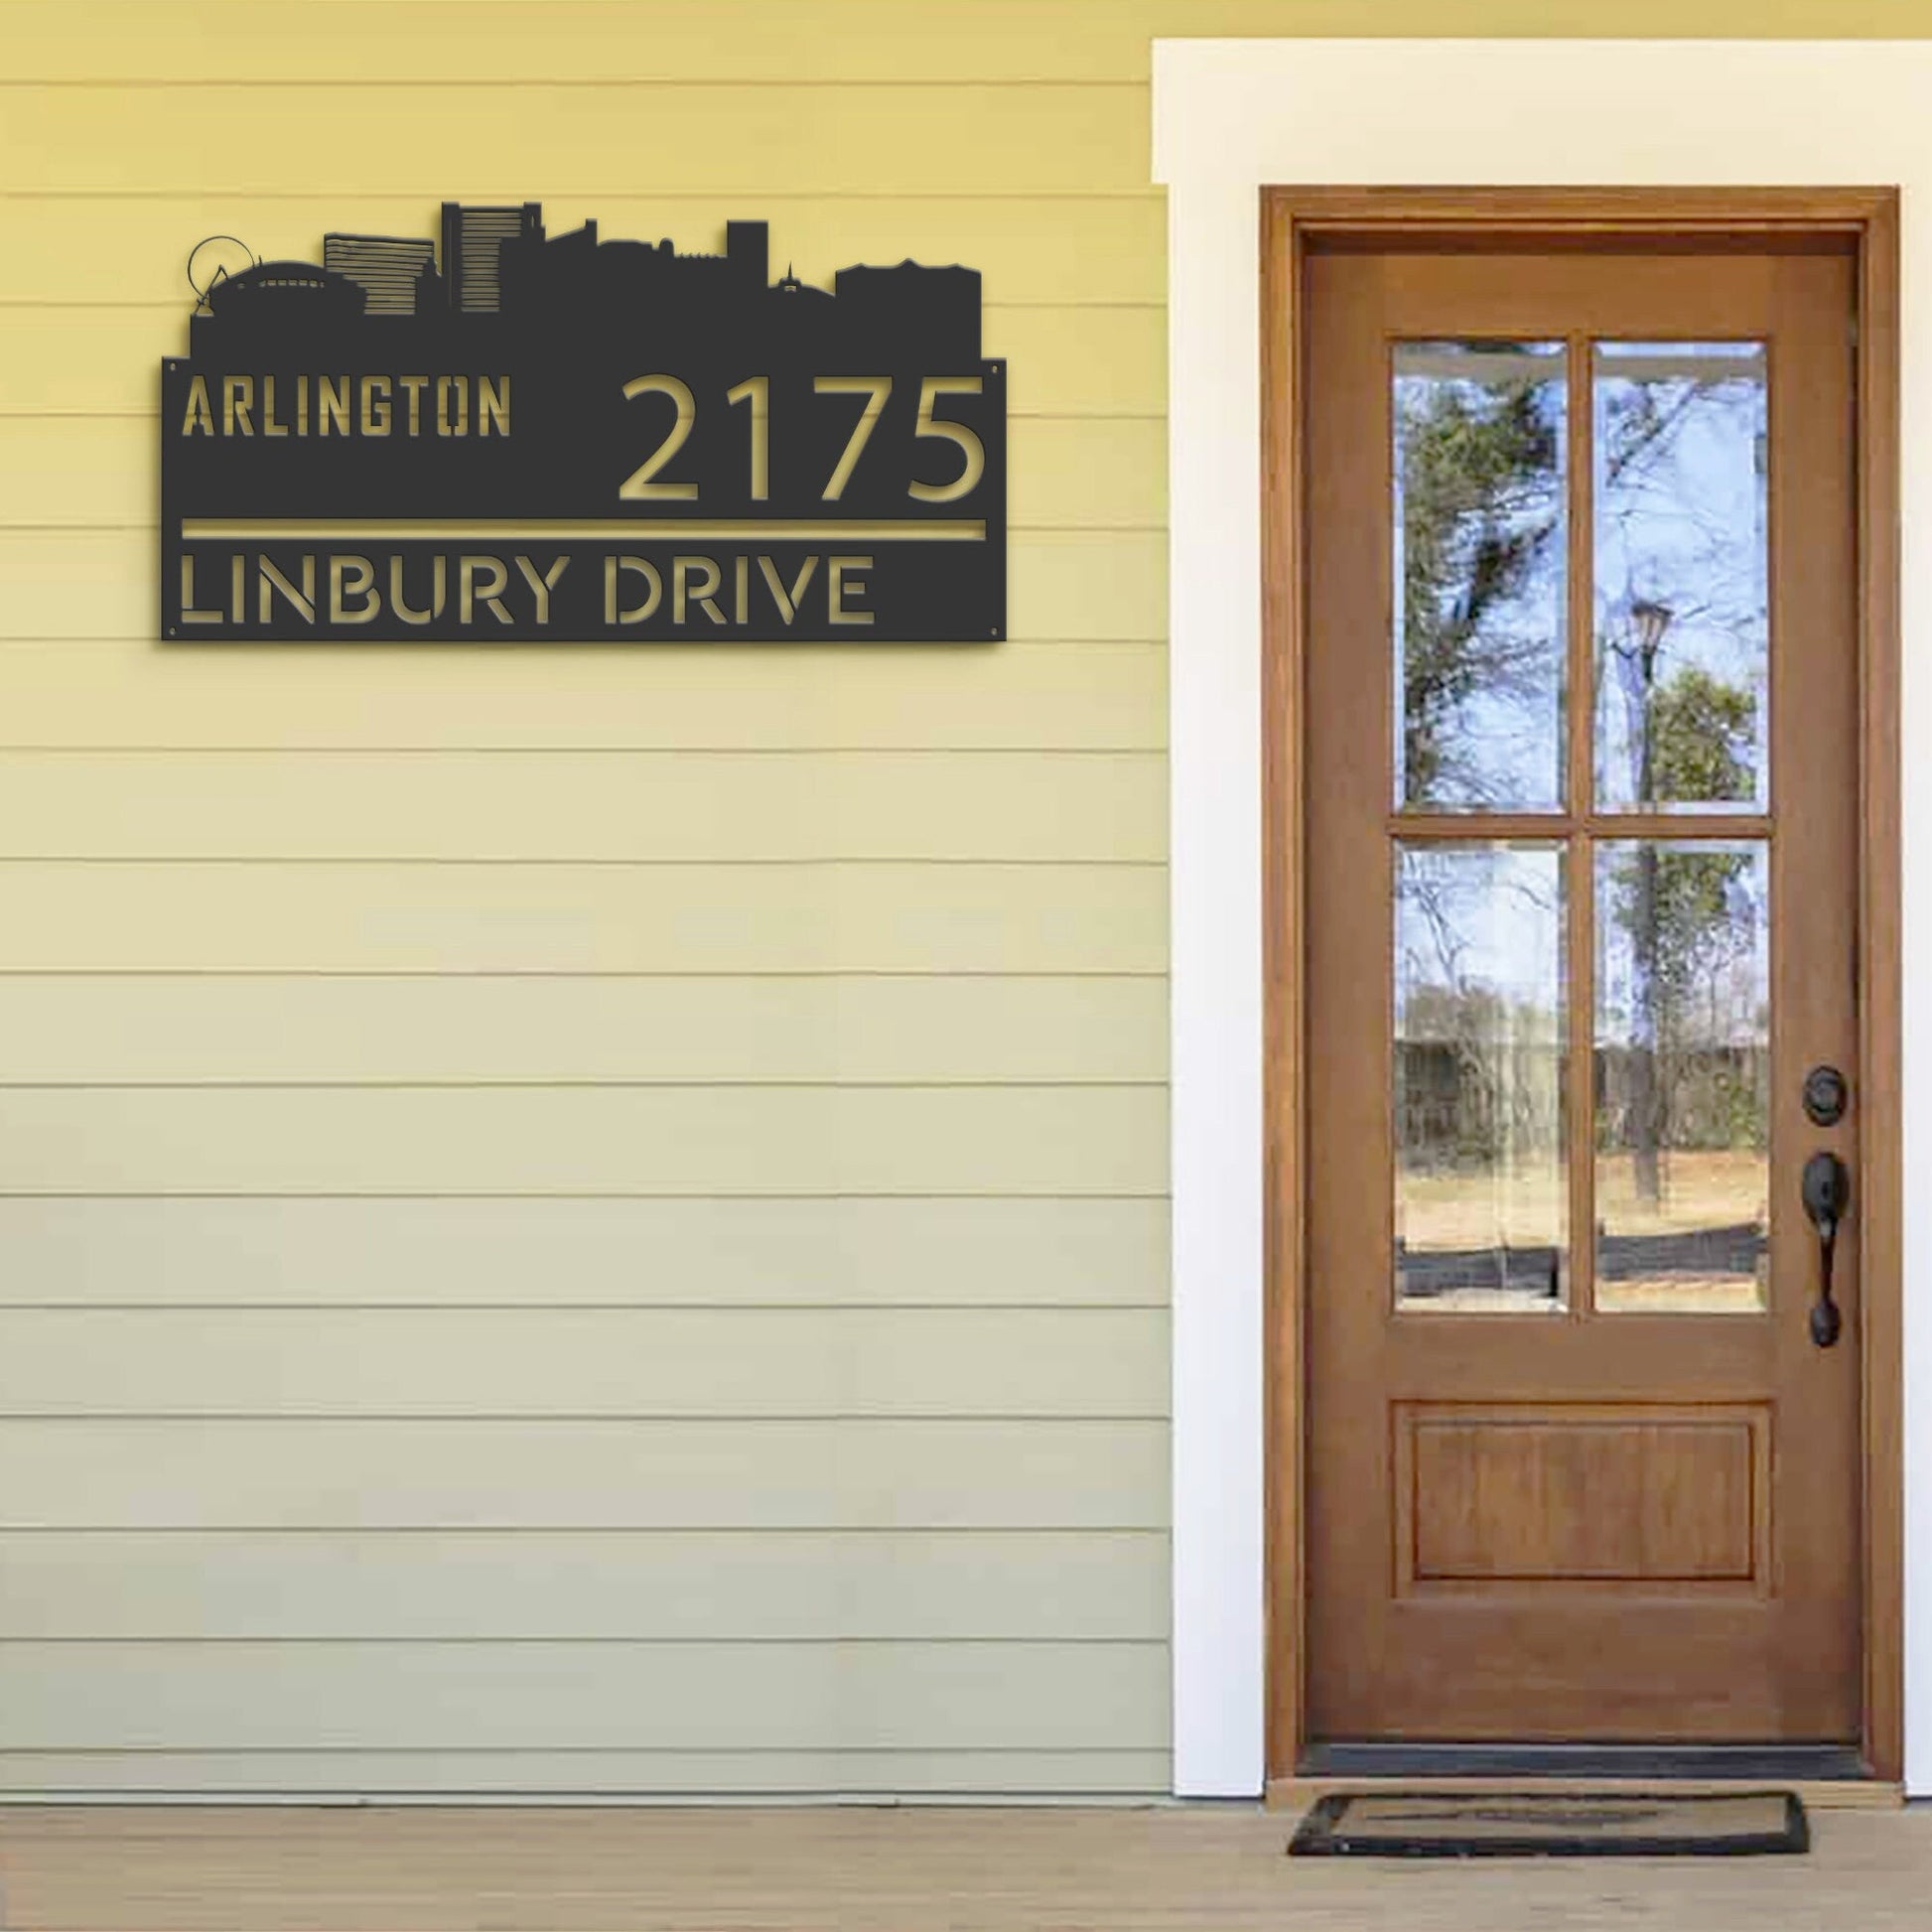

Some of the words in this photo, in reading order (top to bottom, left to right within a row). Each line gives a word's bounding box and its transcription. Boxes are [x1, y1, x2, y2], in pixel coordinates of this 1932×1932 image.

[181, 374, 511, 436] ARLINGTON
[618, 373, 986, 501] 2175
[181, 555, 570, 623] LINBURY
[604, 555, 876, 623] DRIVE
